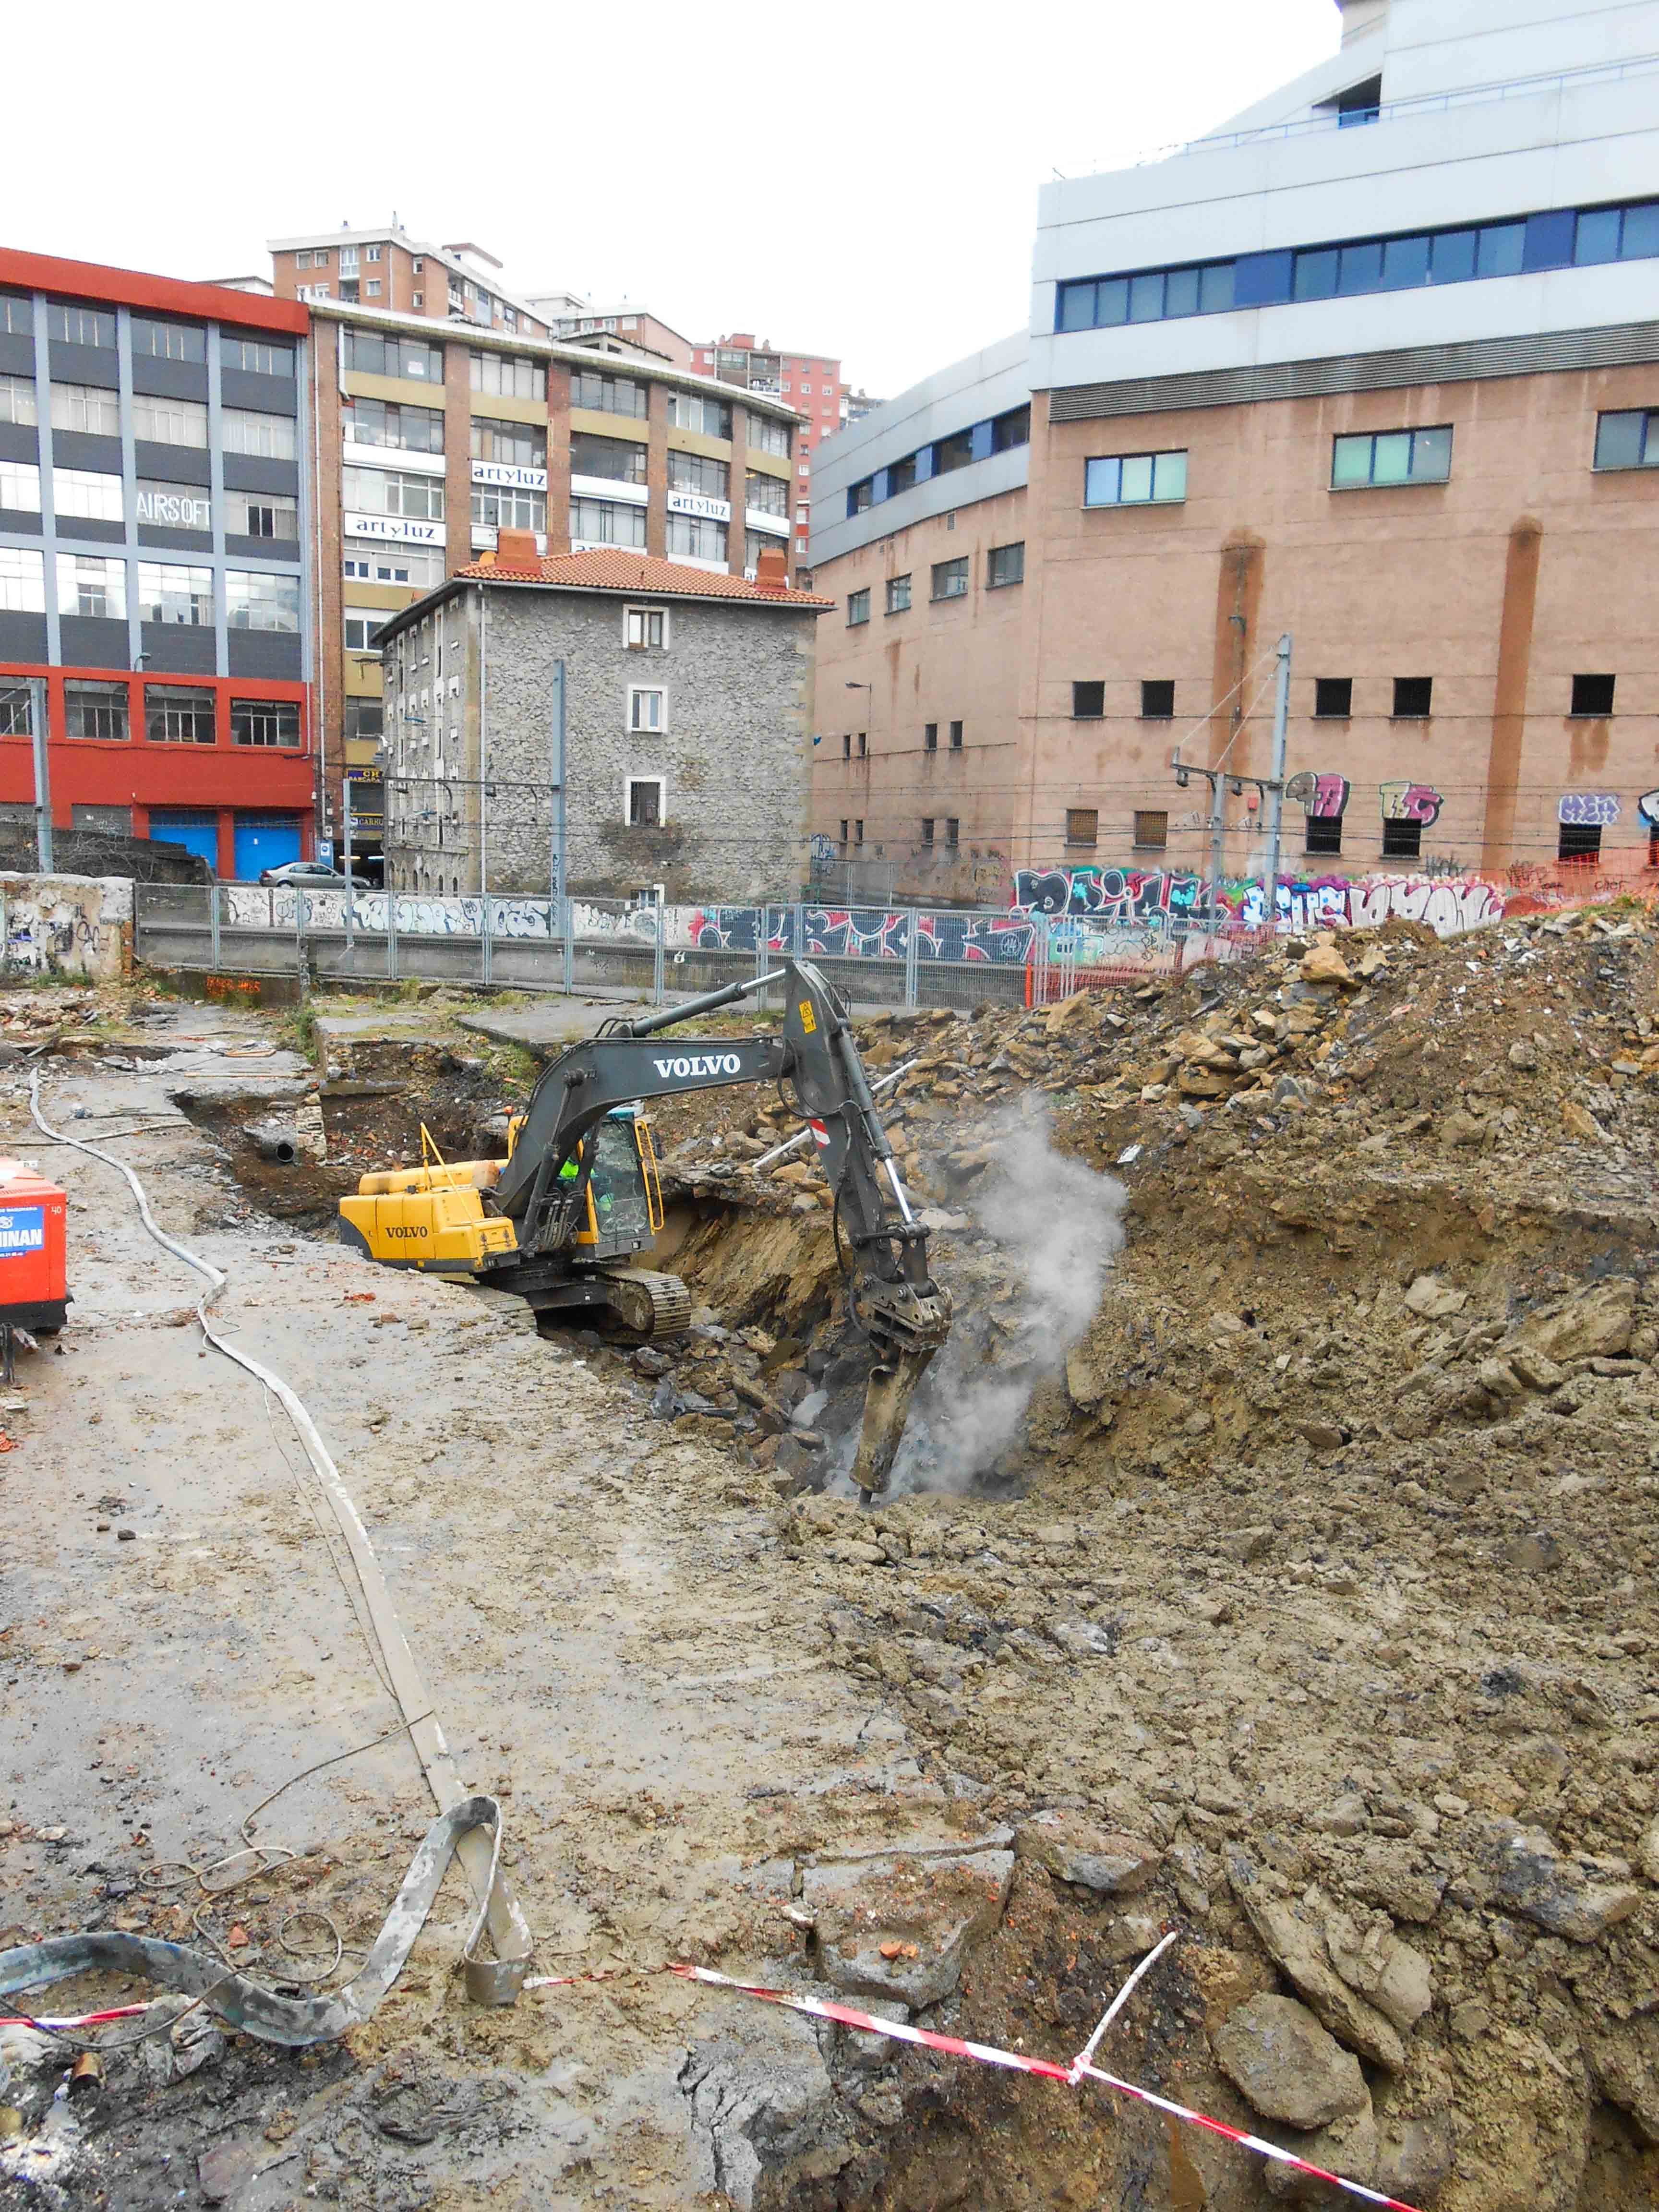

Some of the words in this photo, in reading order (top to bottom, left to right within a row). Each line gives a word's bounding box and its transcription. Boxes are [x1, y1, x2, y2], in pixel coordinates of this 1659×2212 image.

[474, 467, 546, 486] artyluz
[136, 492, 211, 526] AIRSOFT
[673, 496, 726, 517] artyluz
[357, 519, 435, 539] artyluz
[653, 1054, 741, 1078] VOLVO
[51, 1206, 61, 1214] 40
[385, 1226, 428, 1238] VOLVO
